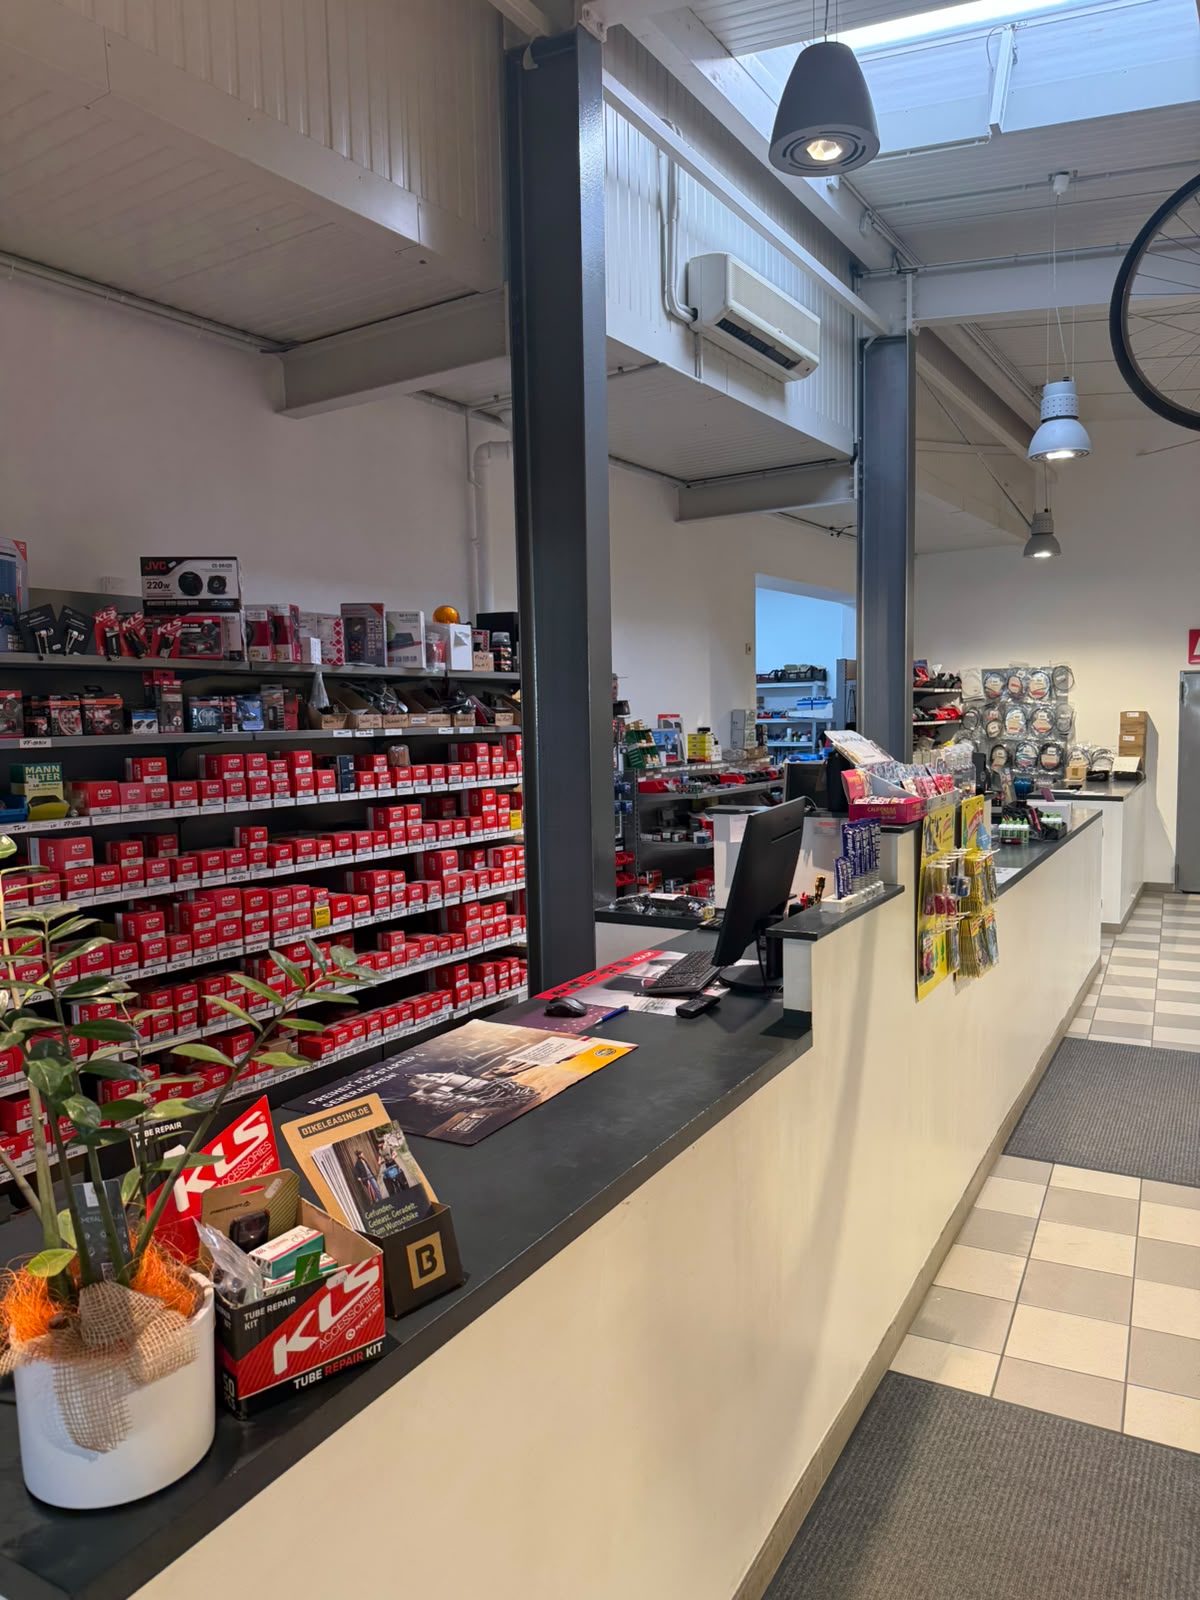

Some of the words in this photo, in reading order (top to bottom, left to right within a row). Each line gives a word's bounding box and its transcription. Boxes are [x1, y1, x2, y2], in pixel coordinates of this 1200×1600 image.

[144, 561, 167, 571] JVC
[122, 611, 144, 631] KLS
[157, 618, 182, 636] KLS
[25, 765, 60, 774] MANN
[308, 1081, 356, 1105] FREIHEIT
[133, 1129, 155, 1140] TBE
[155, 1121, 182, 1135] REPAIR
[301, 1106, 370, 1136] BIKELEASING.DE
[173, 1110, 269, 1213] KLS
[216, 1141, 272, 1188] CCESSORIES
[365, 1203, 394, 1220] Gefunden.
[368, 1214, 391, 1229] Geleast.
[391, 1202, 418, 1218] Geradelt.
[384, 1211, 419, 1231] Wunschbike
[415, 1243, 437, 1279] B
[244, 1307, 265, 1320] TUBE
[266, 1295, 296, 1313] REPAIR
[272, 1257, 380, 1376] KLS
[318, 1285, 381, 1349] ACCESSORIES
[244, 1319, 259, 1331] KIT
[293, 1369, 323, 1390] TUBE
[325, 1352, 364, 1377] REPAIR
[366, 1342, 383, 1358] KIT
